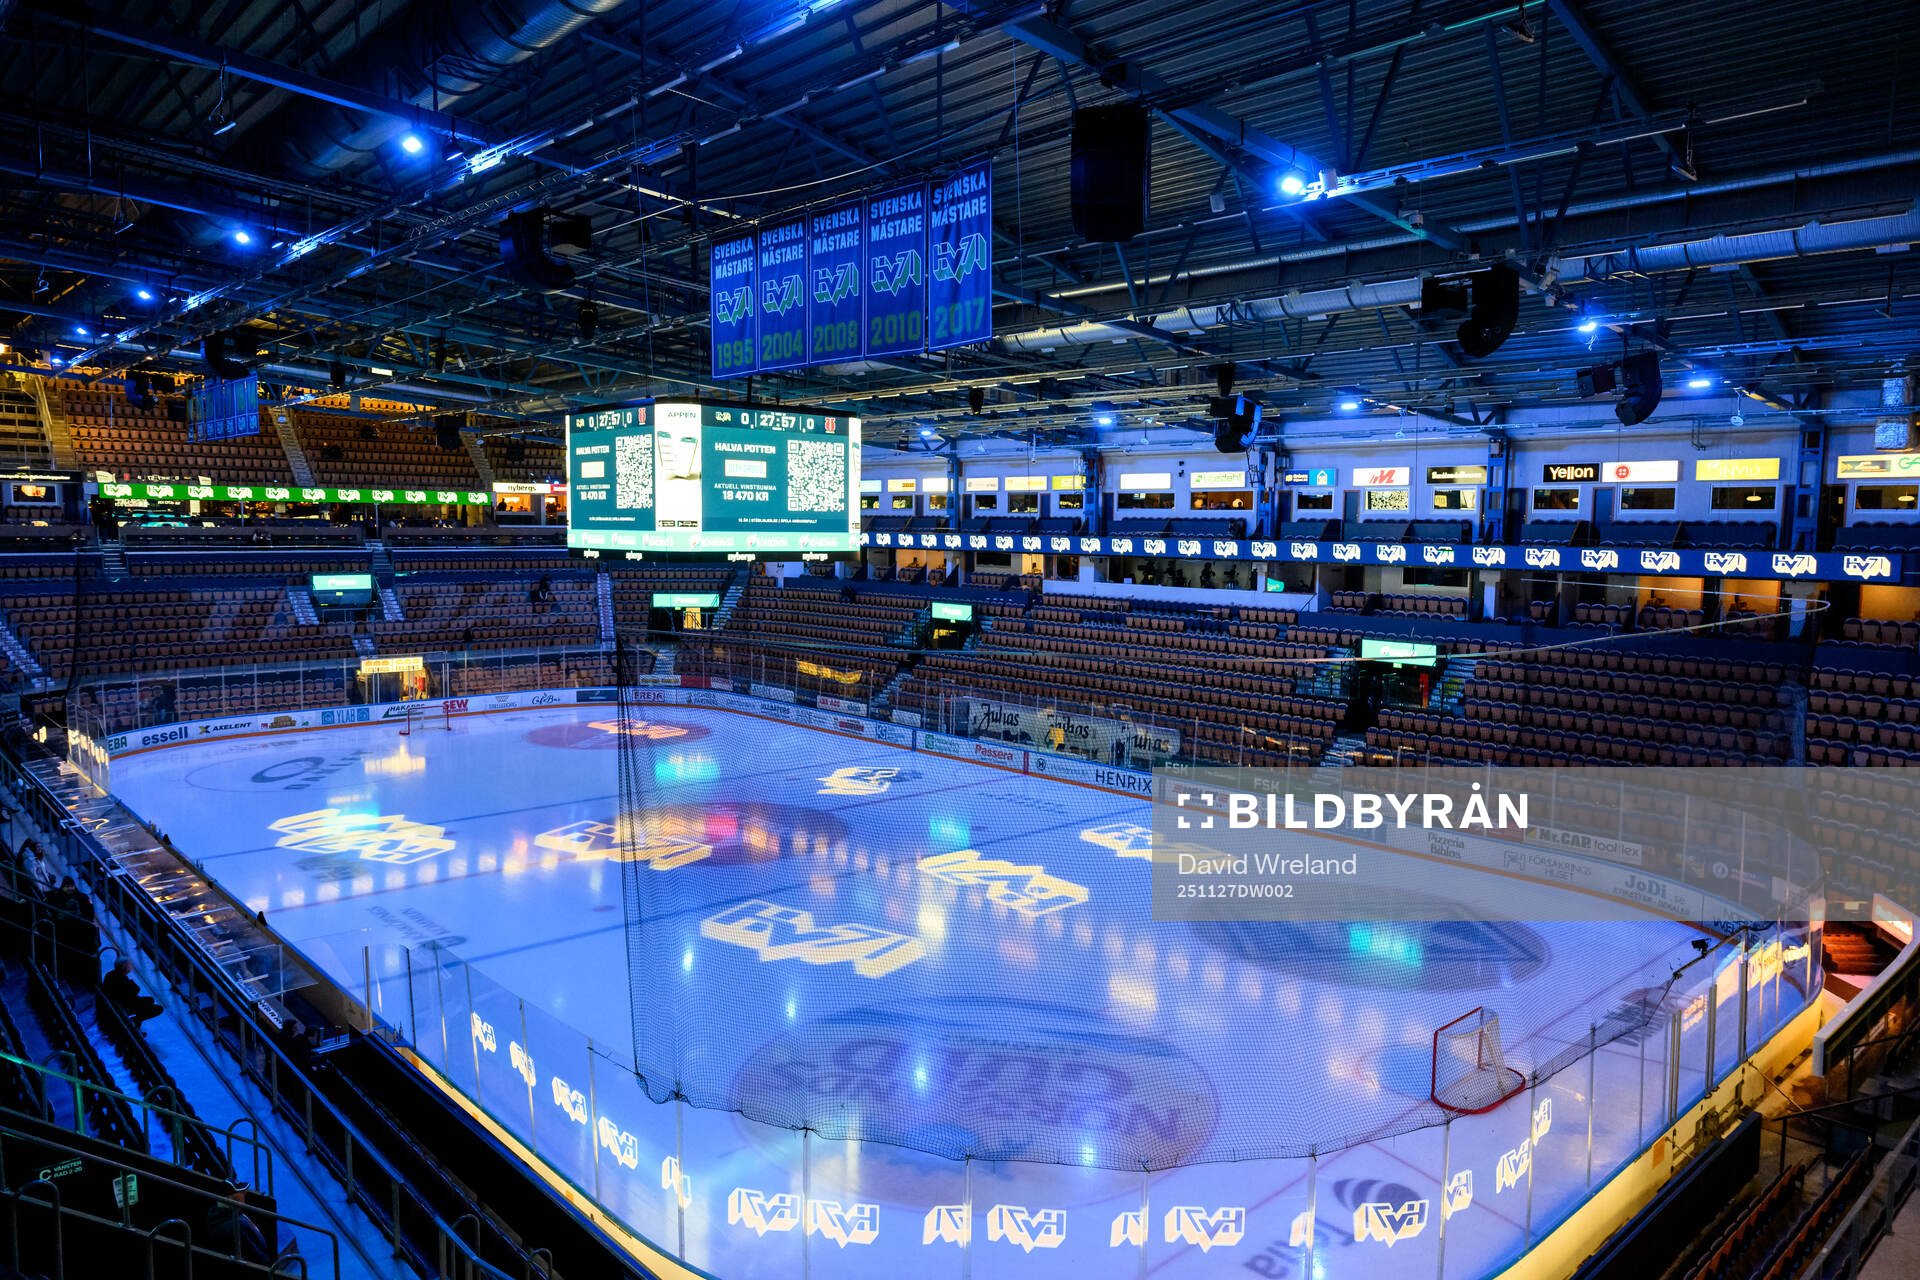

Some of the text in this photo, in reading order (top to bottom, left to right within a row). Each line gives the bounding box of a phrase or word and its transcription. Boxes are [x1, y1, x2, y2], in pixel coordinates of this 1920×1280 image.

[933, 170, 987, 206] SVENSKA
[871, 190, 922, 219] SVENSKA
[931, 195, 987, 229] MÄSTARE
[813, 207, 859, 233] SVENSKA
[871, 214, 922, 243] MÄSTARE
[762, 222, 803, 245] SVENSKA
[813, 229, 859, 255] MÄSTARE
[715, 236, 753, 260] SVENSKA
[762, 242, 803, 268] MÄSTARE
[715, 257, 753, 280] MÄSTARE
[871, 310, 921, 346] 2010
[935, 297, 985, 339] 2017
[763, 329, 803, 361] 2004
[814, 320, 858, 353] 2008
[717, 339, 753, 369] 1995
[599, 413, 621, 427] 27:57
[667, 411, 697, 419] APPEN
[759, 414, 796, 430] 27:57
[714, 443, 777, 455] HALVA POTTEN
[1549, 466, 1594, 481] Yellon
[508, 484, 537, 493] nybergs
[722, 490, 769, 502] 18 470 KR
[728, 551, 756, 562] nybergs
[802, 551, 829, 561] nybergs
[443, 699, 469, 709] SEW
[142, 726, 188, 747] essell
[212, 722, 253, 733] AXELENT
[975, 744, 1013, 761] Passera
[1164, 761, 1189, 776] FSK
[1253, 777, 1281, 794] FSK
[1428, 833, 1465, 850] Pizzeria
[1430, 844, 1461, 860] Biblos
[1625, 875, 1668, 898] JoDi
[1613, 887, 1653, 904] ETIKETTER
[1658, 901, 1690, 916] DEKALER
[40, 1169, 52, 1181] C
